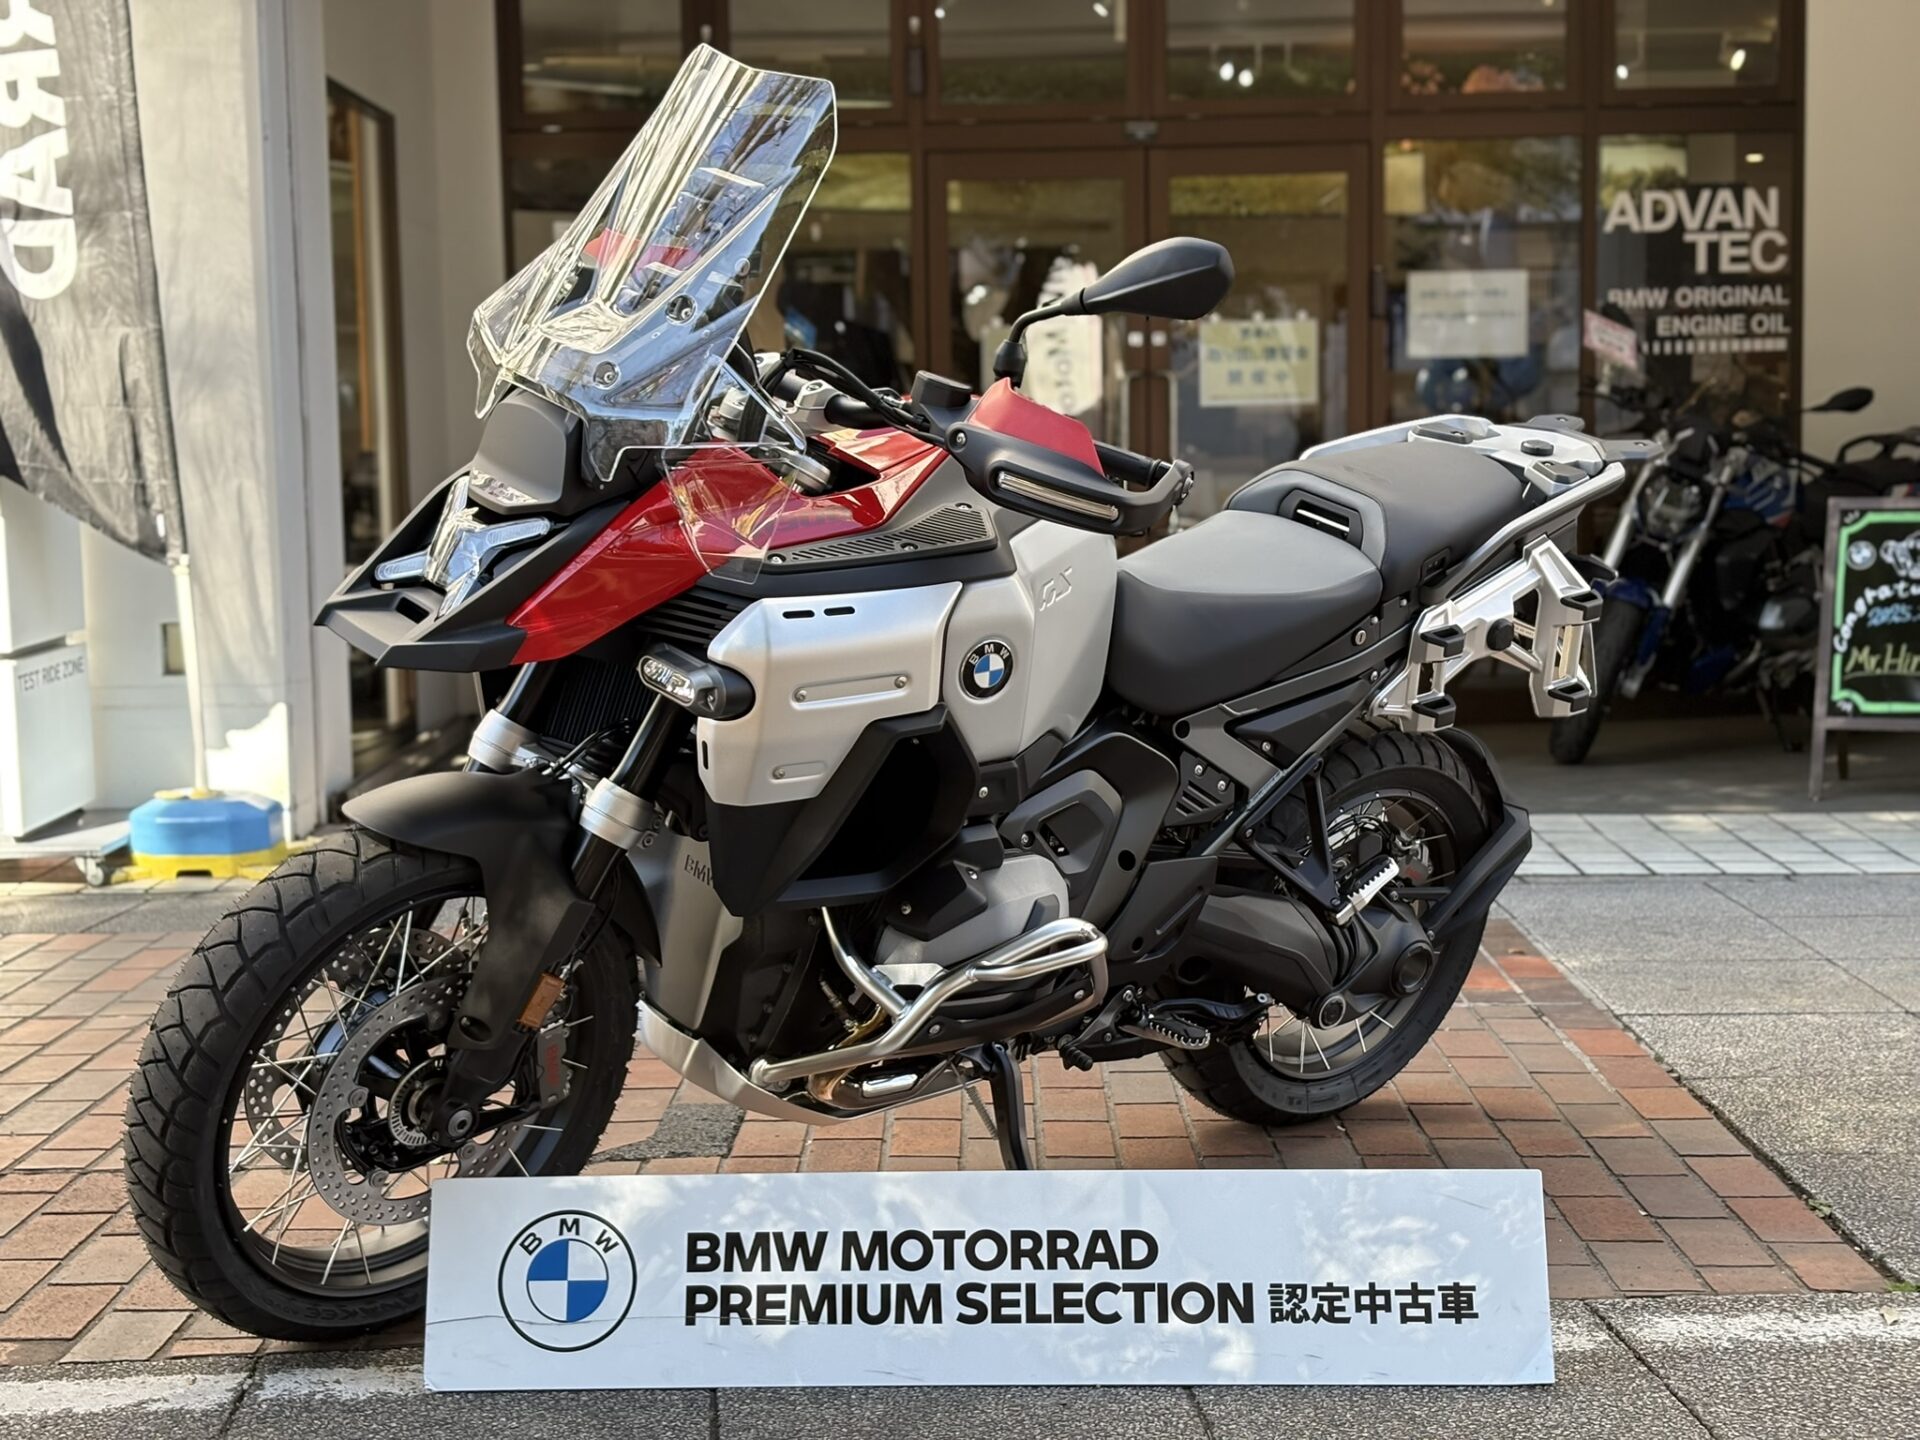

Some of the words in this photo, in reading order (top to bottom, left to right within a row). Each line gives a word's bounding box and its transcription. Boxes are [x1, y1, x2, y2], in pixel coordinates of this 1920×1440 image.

[1603, 186, 1779, 234] ADVAN
[1682, 231, 1788, 274] TEC
[1675, 285, 1790, 307] ORIGINAL
[1656, 315, 1746, 336] ENGINE
[1750, 313, 1790, 335] OIL
[17, 669, 40, 691] TEST
[42, 662, 61, 684] RIDE
[63, 656, 84, 679] ZONE
[684, 854, 712, 887] BM
[519, 1217, 620, 1257] BMW
[686, 1231, 829, 1272] BMW
[841, 1229, 1159, 1272] MOTORRAD
[685, 1283, 943, 1326] PREMIUM
[955, 1281, 1254, 1325] SELECTION
[1267, 1281, 1479, 1325] 認定中古車
